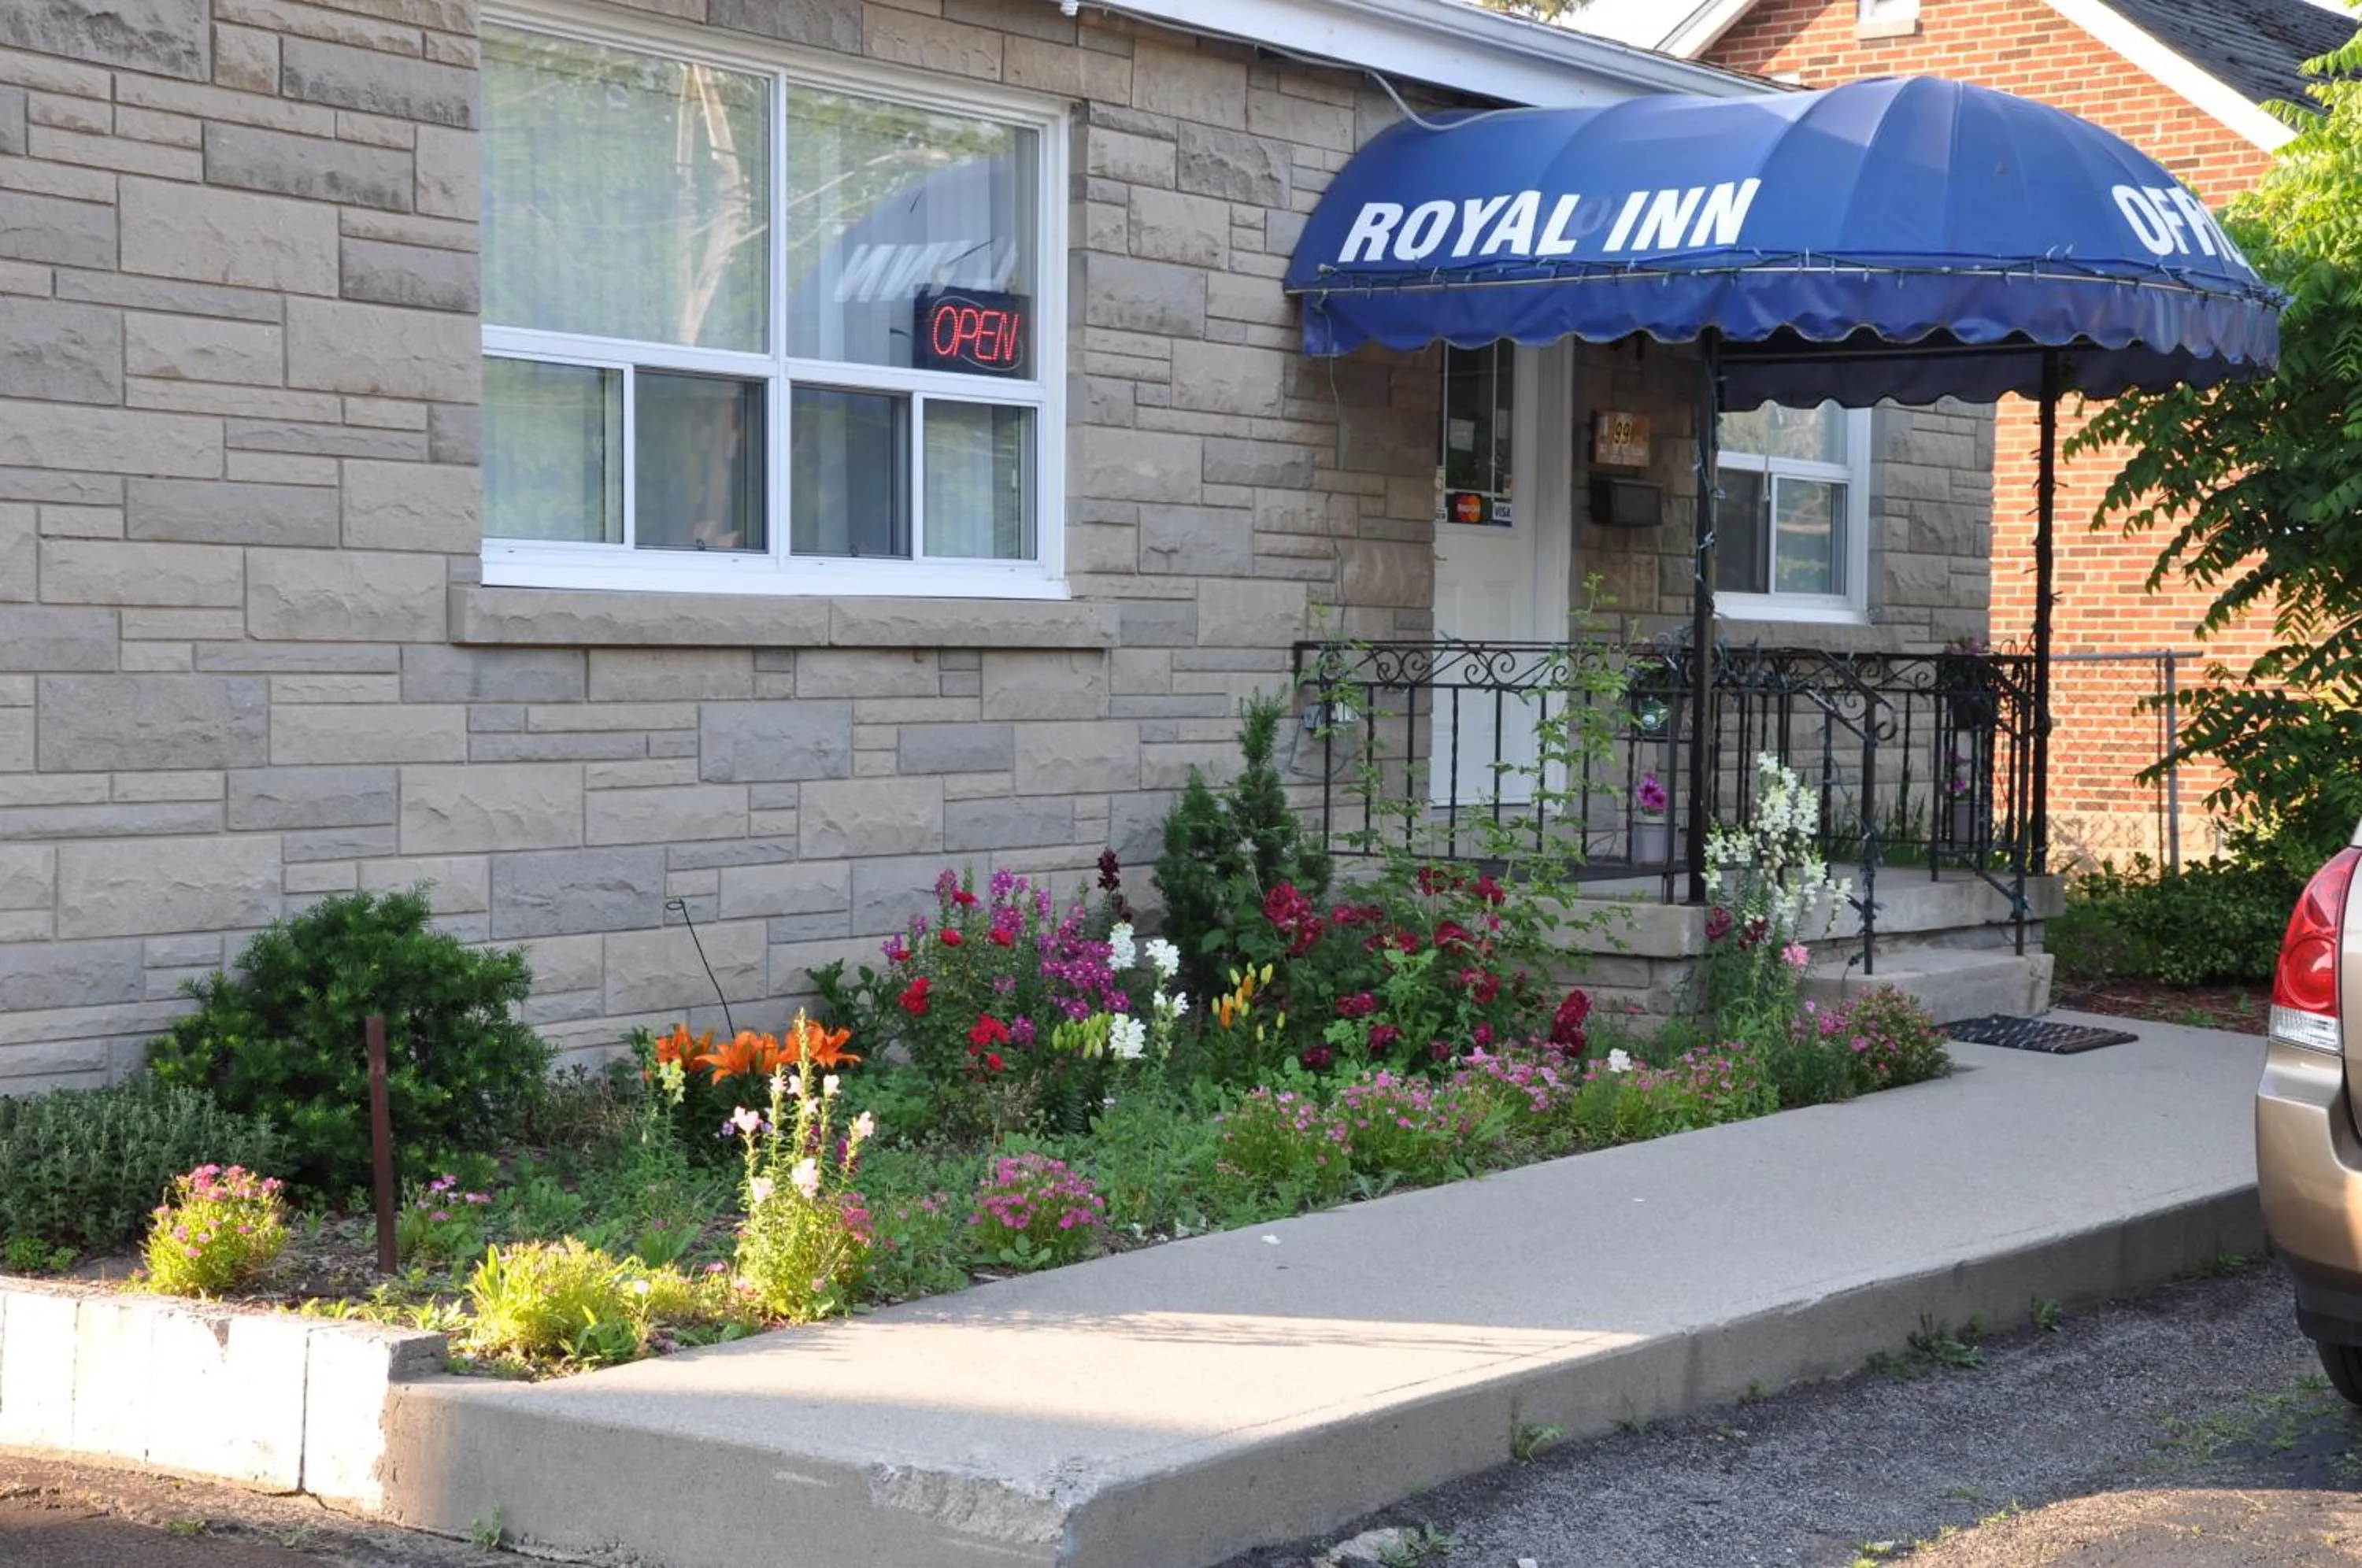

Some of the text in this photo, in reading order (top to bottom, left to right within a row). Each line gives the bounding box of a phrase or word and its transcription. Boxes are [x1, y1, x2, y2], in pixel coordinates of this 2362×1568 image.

[1338, 178, 1761, 262] ROYAL INN
[932, 305, 1019, 361] OPEN
